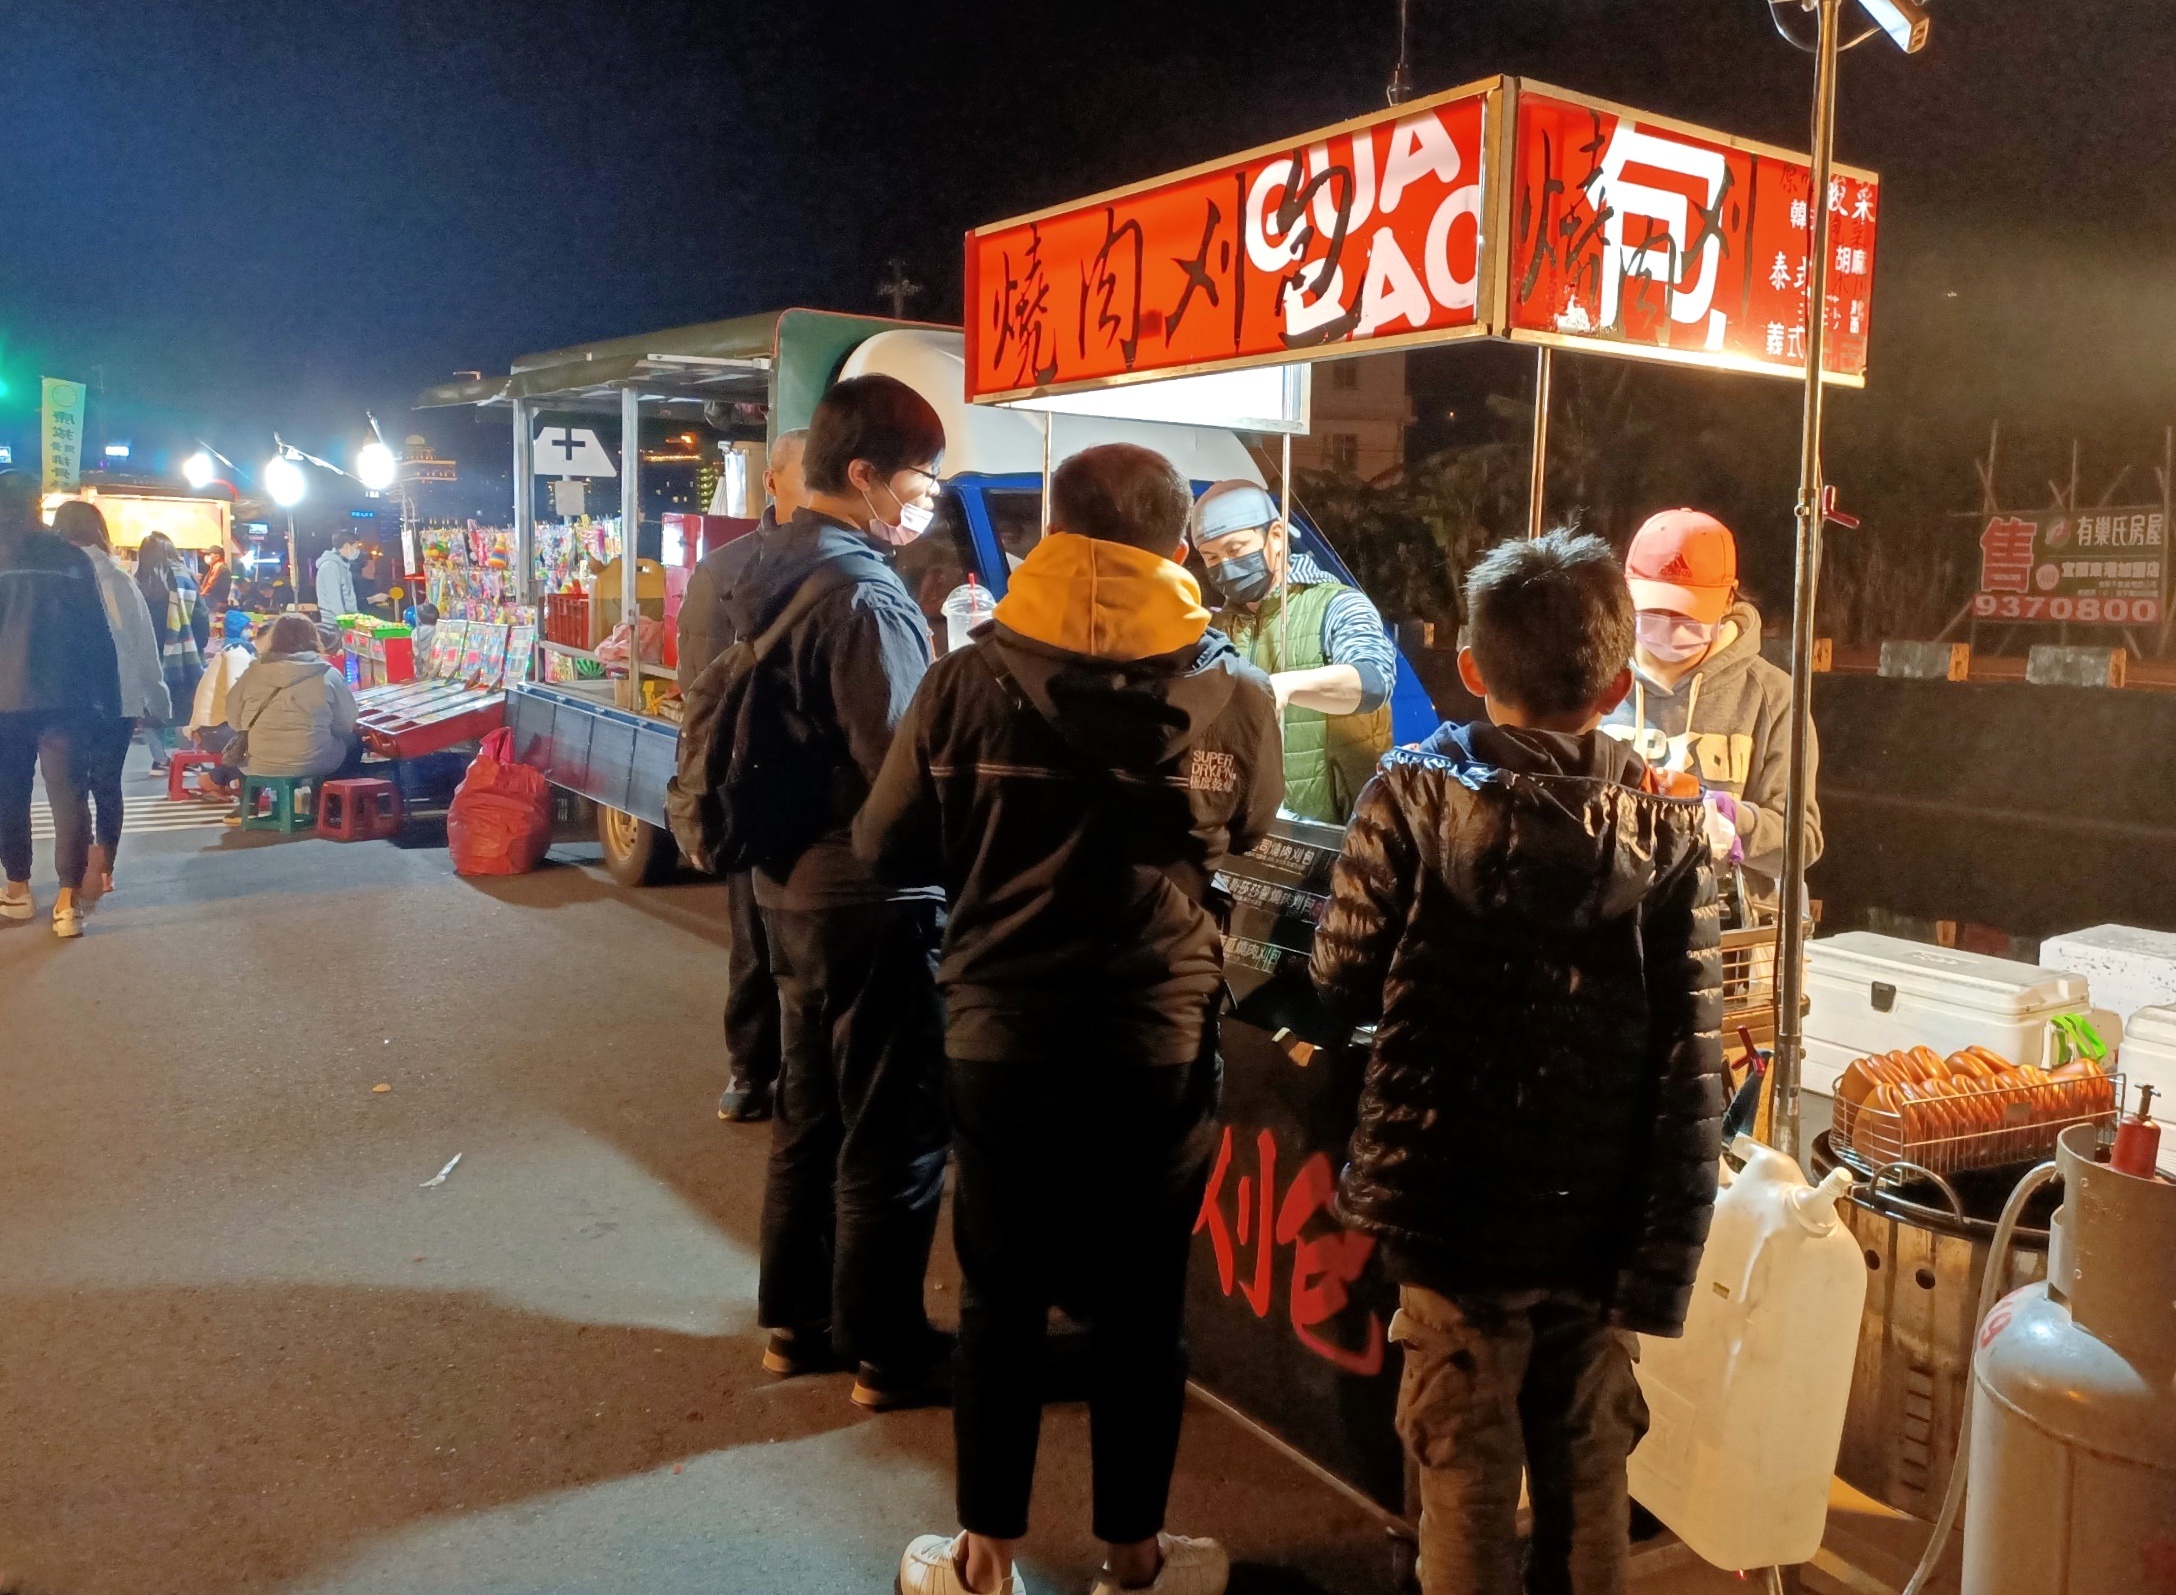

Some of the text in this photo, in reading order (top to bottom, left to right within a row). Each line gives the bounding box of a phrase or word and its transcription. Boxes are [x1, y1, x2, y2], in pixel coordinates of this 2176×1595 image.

[1246, 108, 1461, 273] GUA
[2077, 513, 2163, 547] 有巢氏房屋
[1975, 595, 2157, 622] 9370800
[1193, 750, 1234, 767] SUPER
